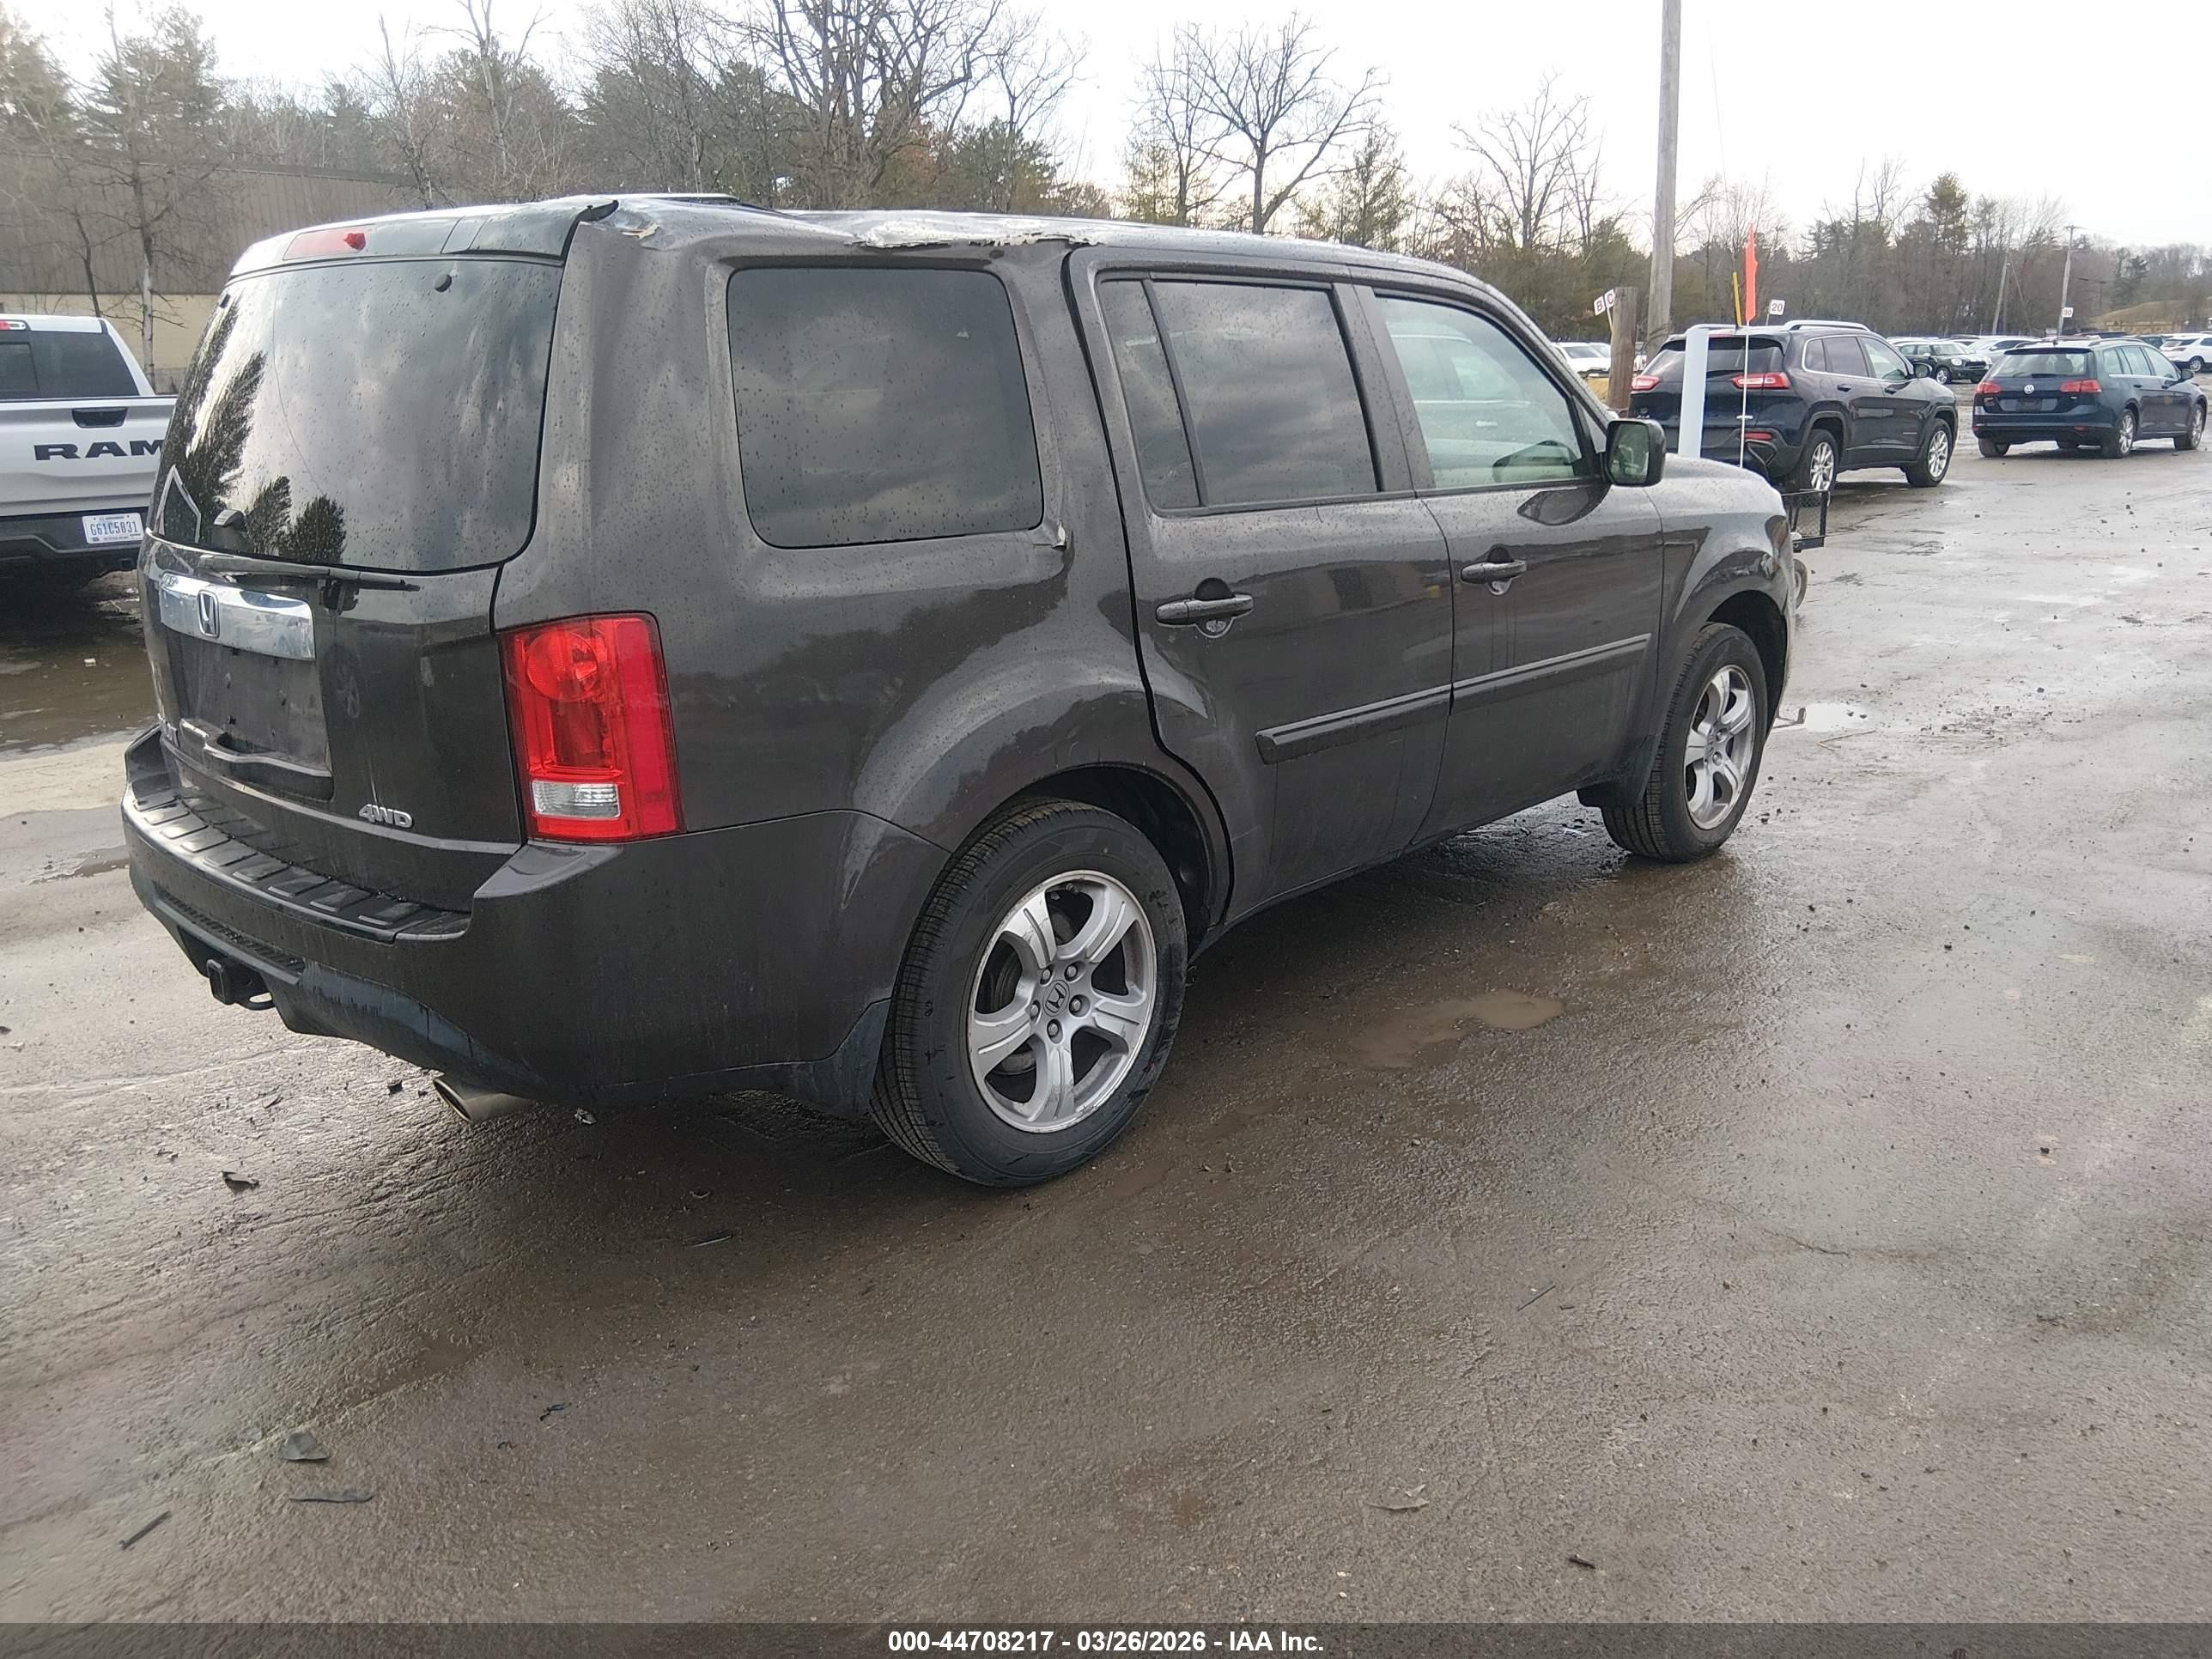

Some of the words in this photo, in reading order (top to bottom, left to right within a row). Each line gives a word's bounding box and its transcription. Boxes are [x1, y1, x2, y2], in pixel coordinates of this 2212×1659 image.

[1607, 293, 1614, 304] C
[1597, 301, 1603, 312] B
[1771, 302, 1784, 312] 20
[33, 439, 165, 461] RAM
[358, 803, 413, 829] 4WD
